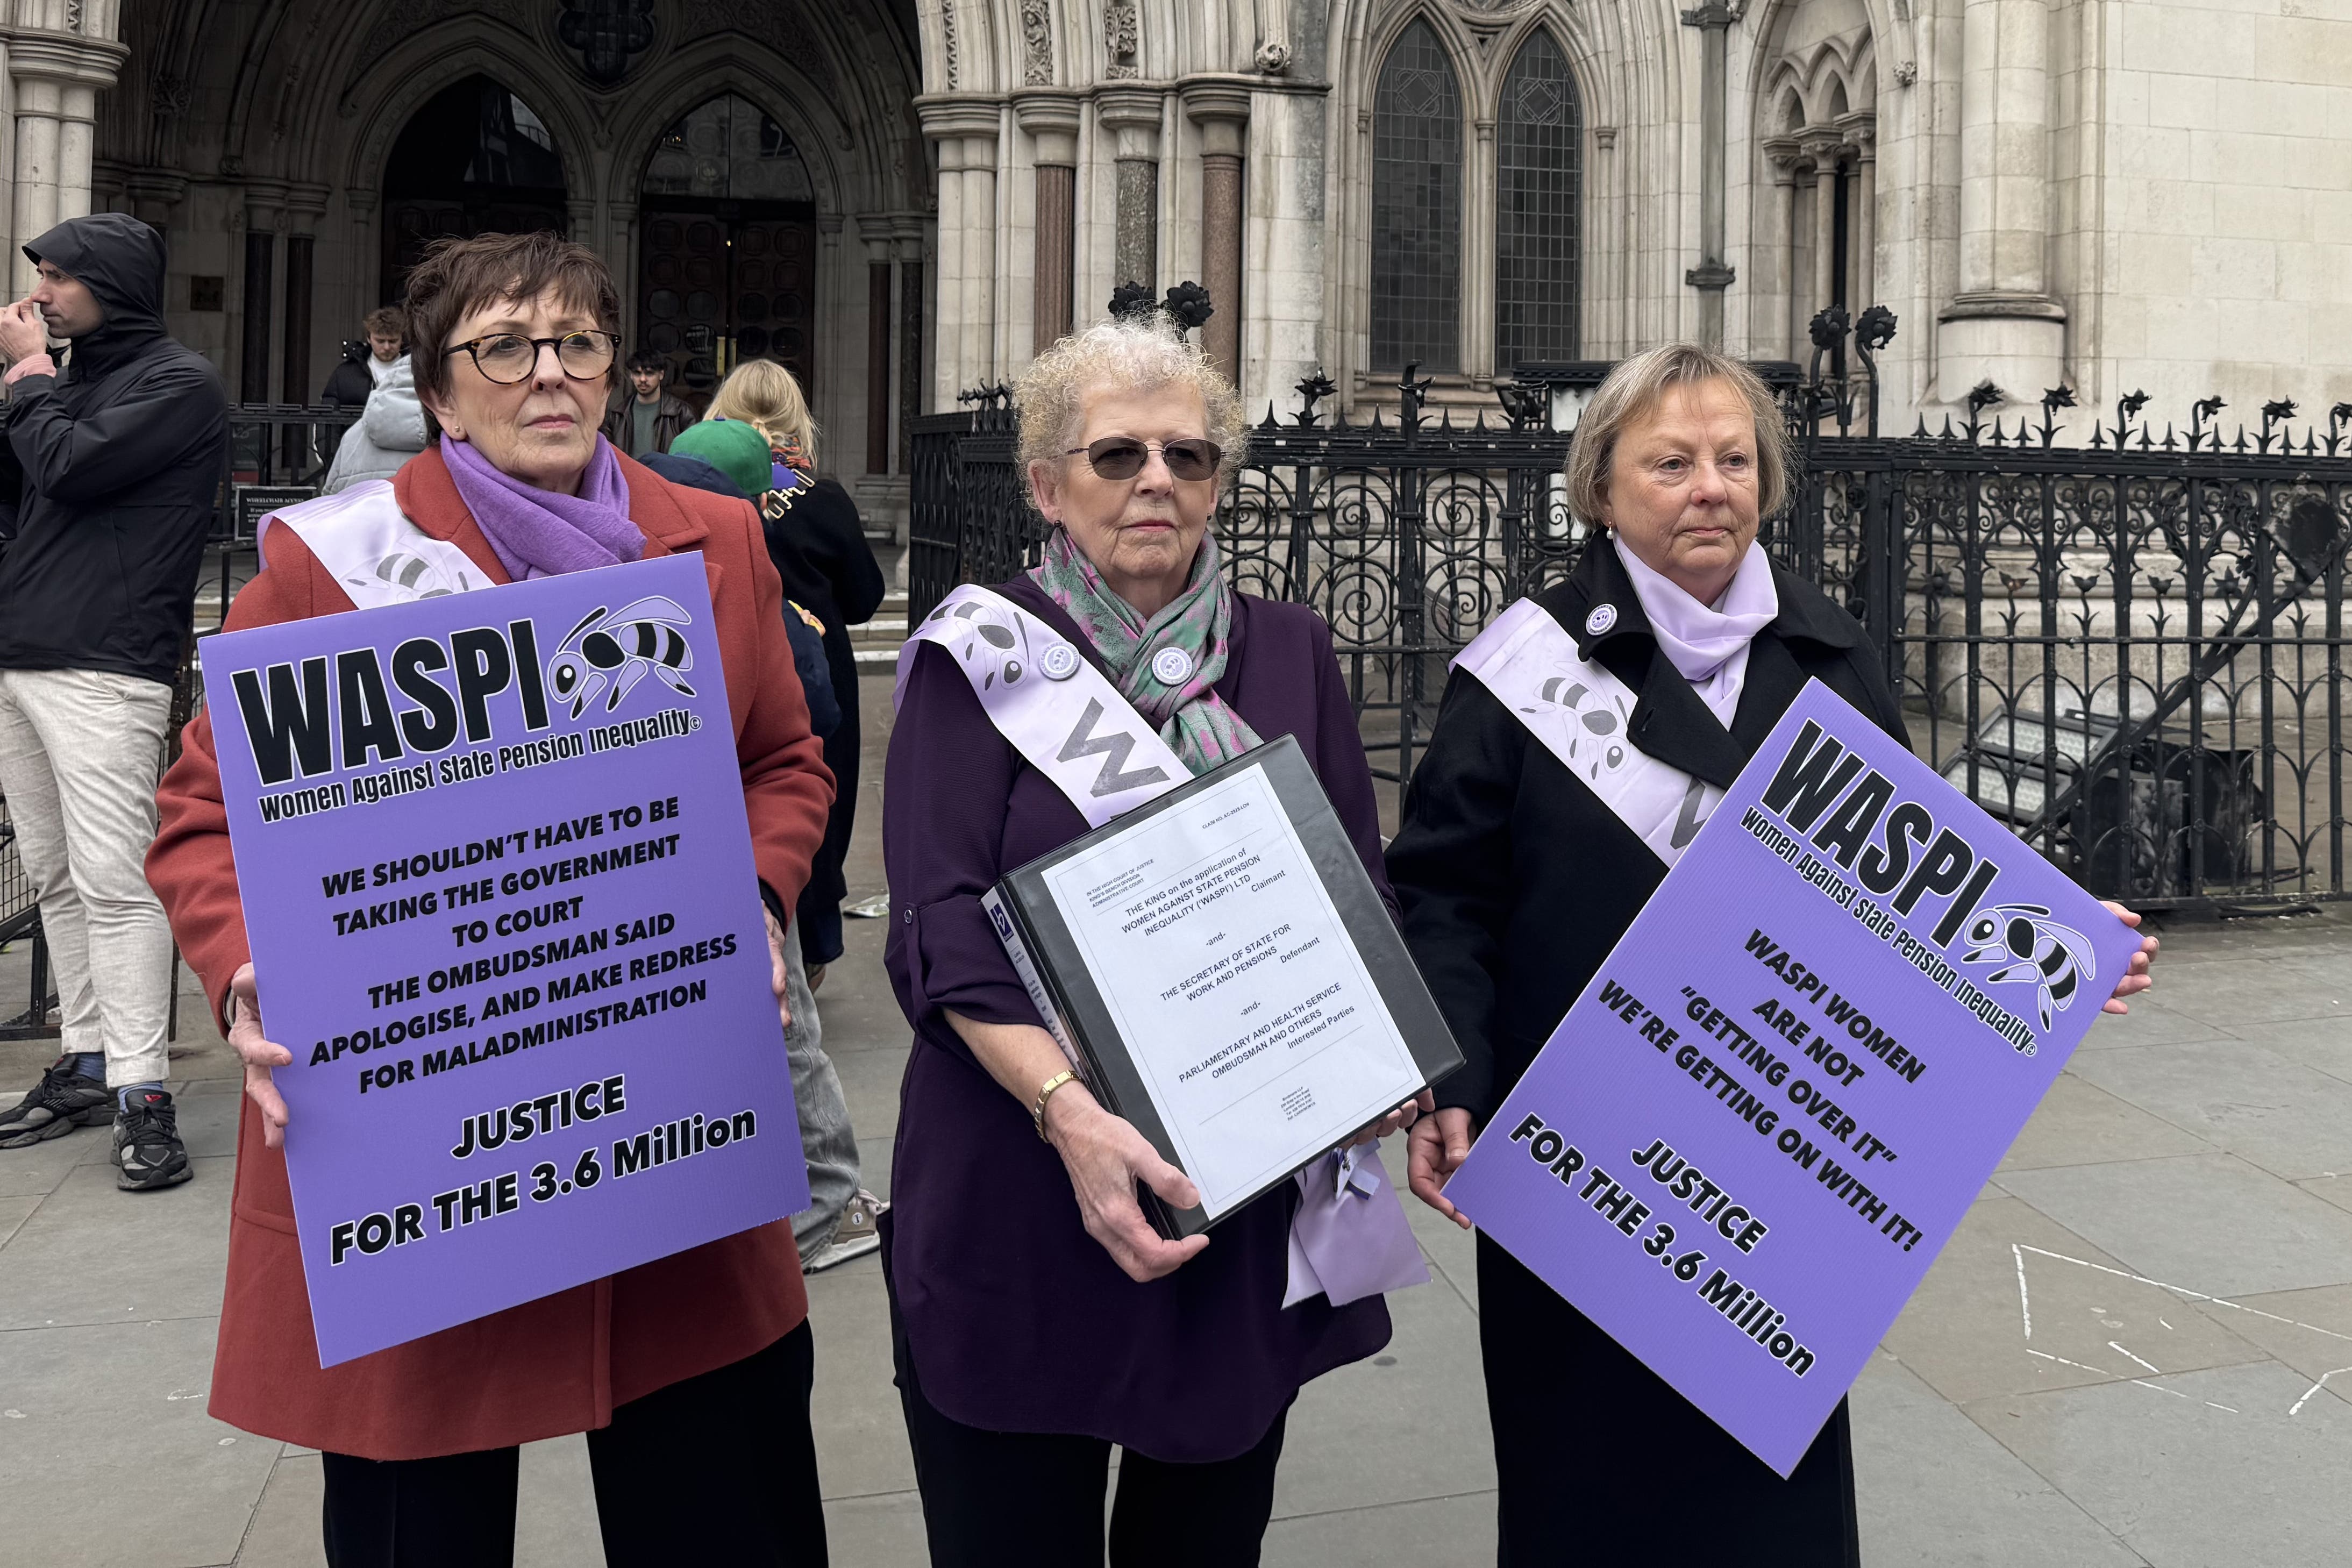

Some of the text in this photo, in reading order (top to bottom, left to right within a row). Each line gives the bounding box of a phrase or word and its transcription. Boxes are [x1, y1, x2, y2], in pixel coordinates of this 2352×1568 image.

[230, 617, 551, 787] WASPI
[258, 781, 347, 824] Women
[351, 759, 437, 805] Against
[438, 749, 496, 786] State
[497, 732, 586, 773] Pension
[322, 796, 679, 899] WE SHOULDN'T HAVE TO BE
[1759, 717, 2001, 951] WASPI
[332, 833, 680, 936] TAKING THE GOVERNMENT
[452, 895, 583, 947] TO COURT
[1121, 854, 1260, 933] WOMEN AGAINST STATE PENSION
[1124, 847, 1246, 916] THE KING on the application of
[1144, 903, 1194, 936] INEQUALITY
[1233, 874, 1250, 887] LTD
[1251, 869, 1286, 892] Claimant
[1739, 805, 1801, 865] Women
[1793, 851, 1861, 911] Against
[1851, 897, 1898, 942] State
[1891, 928, 1959, 992] Pension
[367, 913, 675, 1009] THE OMBUDSMAN SAID
[1160, 923, 1291, 1001] THE SECRETARY OF STATE FOR
[1186, 946, 1277, 1001] WORK AND PENSIONS
[1206, 931, 1225, 945] -and-
[1280, 936, 1320, 963] Defendant
[309, 933, 737, 1067] APOLOGISE, AND MAKE REDRESS
[360, 979, 706, 1094] FOR MALADMINISTRATION
[1179, 982, 1341, 1082] PARLIAMENTARY AND HEALTH SERVICE
[1211, 1009, 1322, 1078] OMBUDSMAN AND OTHERS
[1241, 1001, 1260, 1015] -and-
[1287, 1006, 1354, 1049] Interested Parties
[1744, 929, 1926, 1084] WASPI WOMEN
[1752, 999, 1865, 1087] ARE NOT
[450, 1073, 627, 1160] JUSTICE
[1598, 979, 1923, 1252] WE'RE GETTING ON WITH IT!
[1787, 1080, 1856, 1144] OVER
[330, 1109, 757, 1266] FOR THE 3.6 Million
[1630, 1138, 1769, 1256] JUSTICE
[1507, 1111, 1816, 1379] FOR THE 3.6 Million
